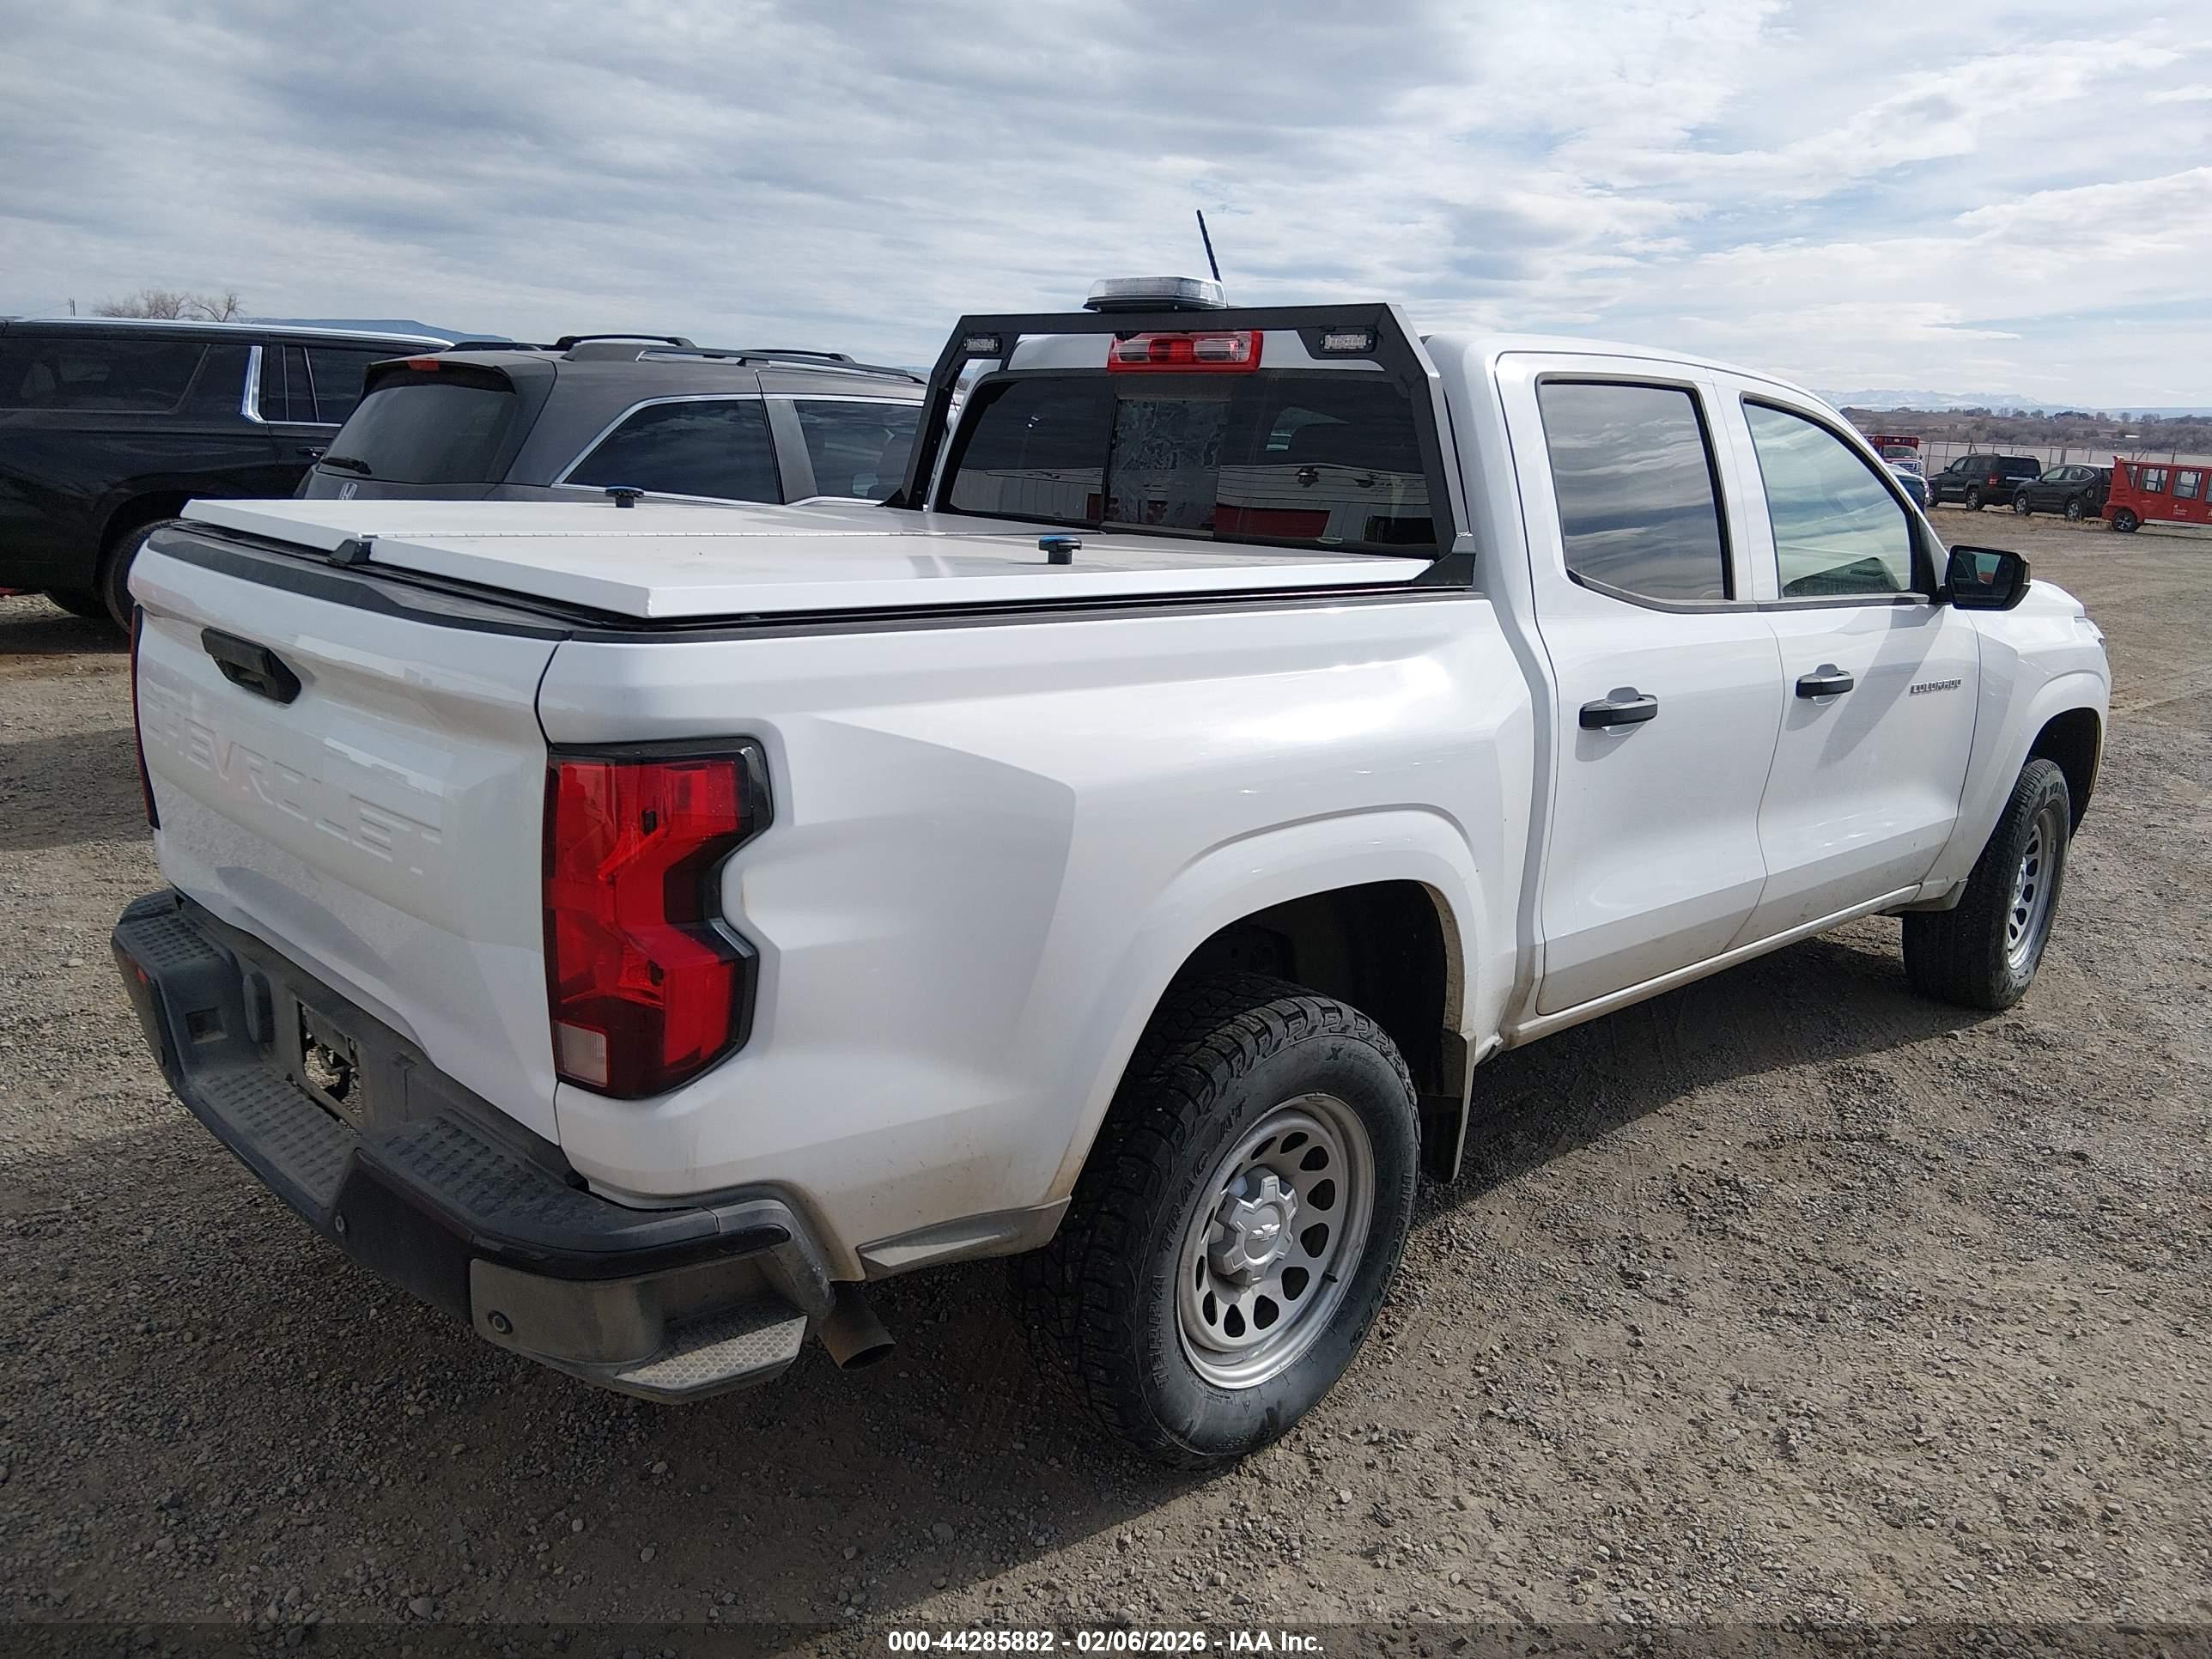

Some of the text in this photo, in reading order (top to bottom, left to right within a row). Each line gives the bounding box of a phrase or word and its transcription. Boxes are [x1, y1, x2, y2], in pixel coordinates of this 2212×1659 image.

[1910, 678, 1963, 694] COLORADO
[142, 692, 443, 877] CHEVROLET
[1147, 1274, 1169, 1390] TERRA
[1159, 1149, 1210, 1252] TRAC
